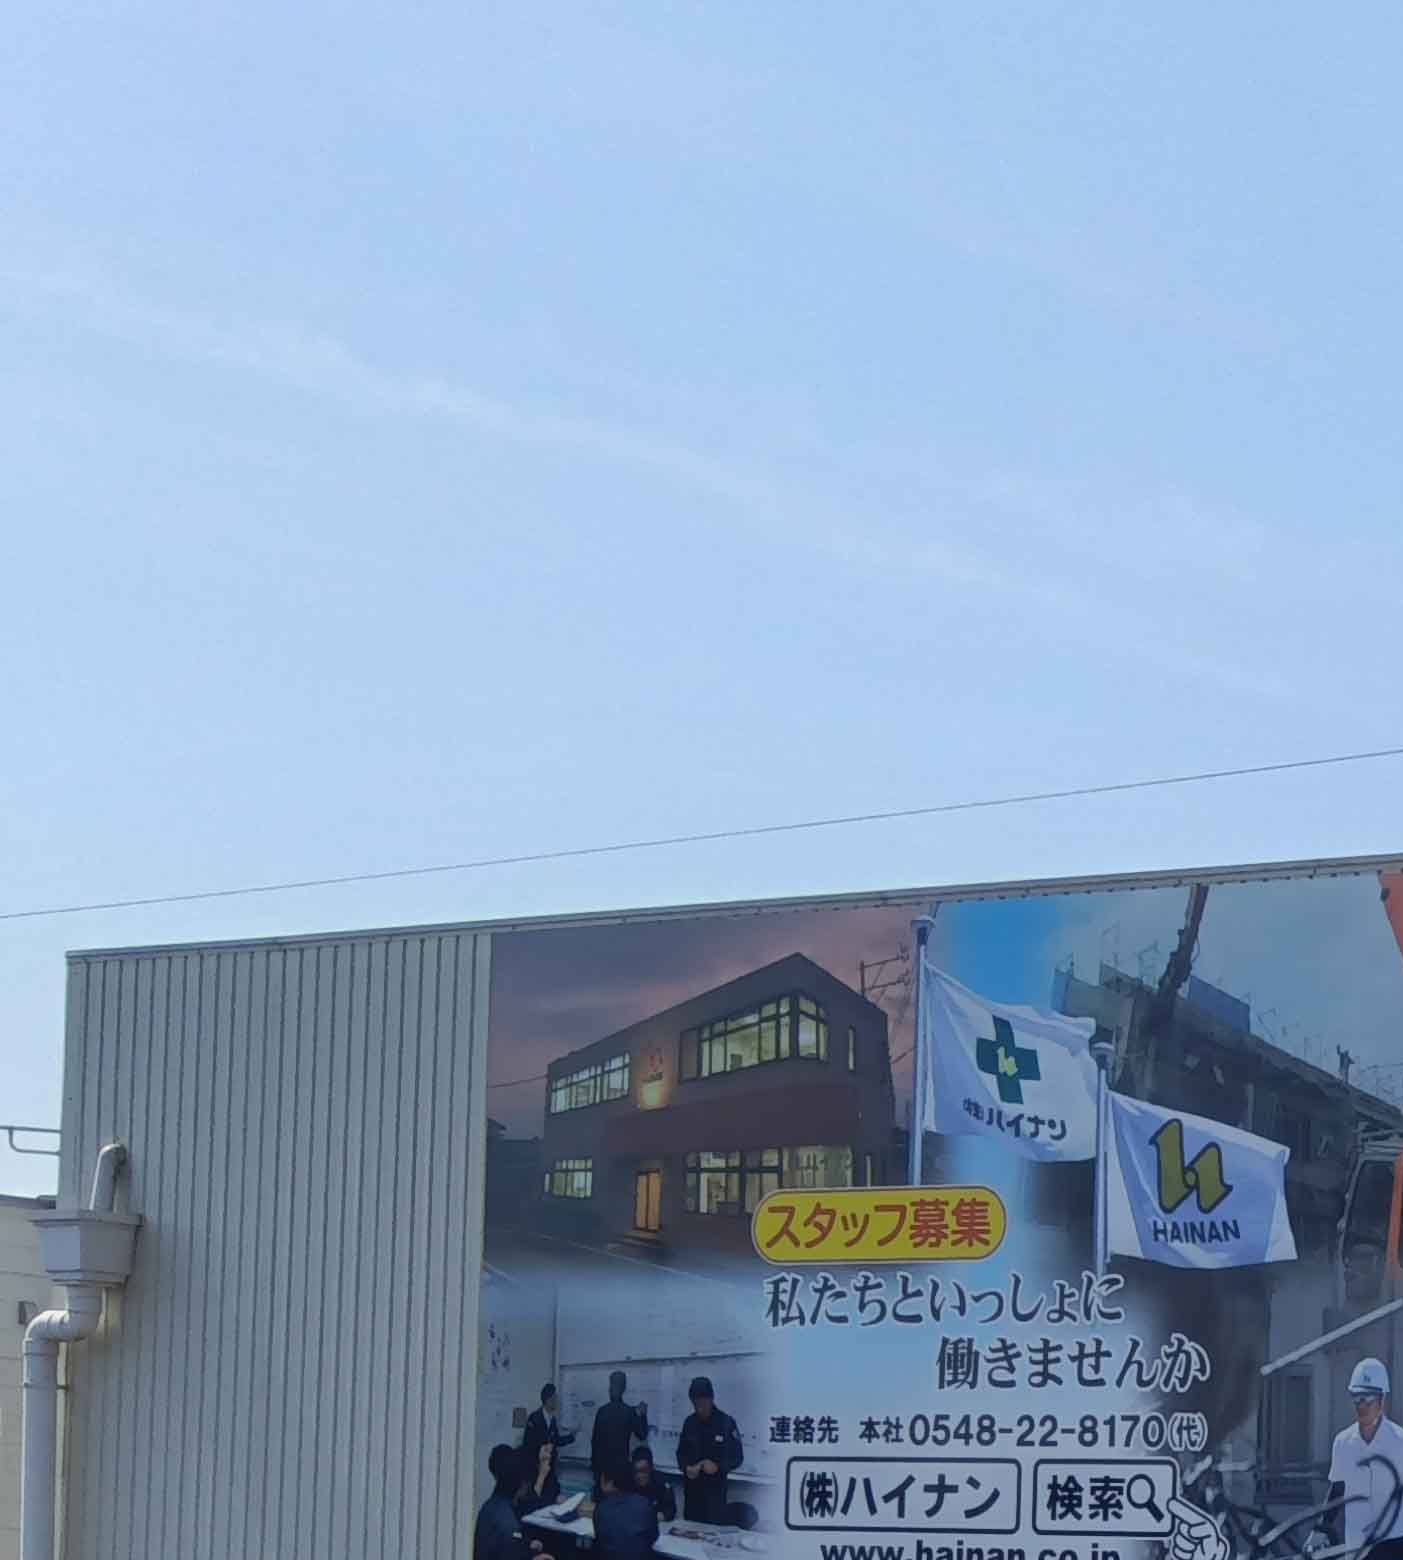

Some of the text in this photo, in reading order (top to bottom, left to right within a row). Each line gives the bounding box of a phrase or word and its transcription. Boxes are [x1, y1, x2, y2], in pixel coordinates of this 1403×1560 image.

[765, 1198, 992, 1250] スタッフ募集
[1152, 1219, 1241, 1246] HAINAN
[766, 1272, 1123, 1327] 私たちといっしょに
[936, 1333, 1210, 1392] 働きませんか
[769, 1415, 840, 1445] 連絡先
[1046, 1475, 1124, 1522] 検索
